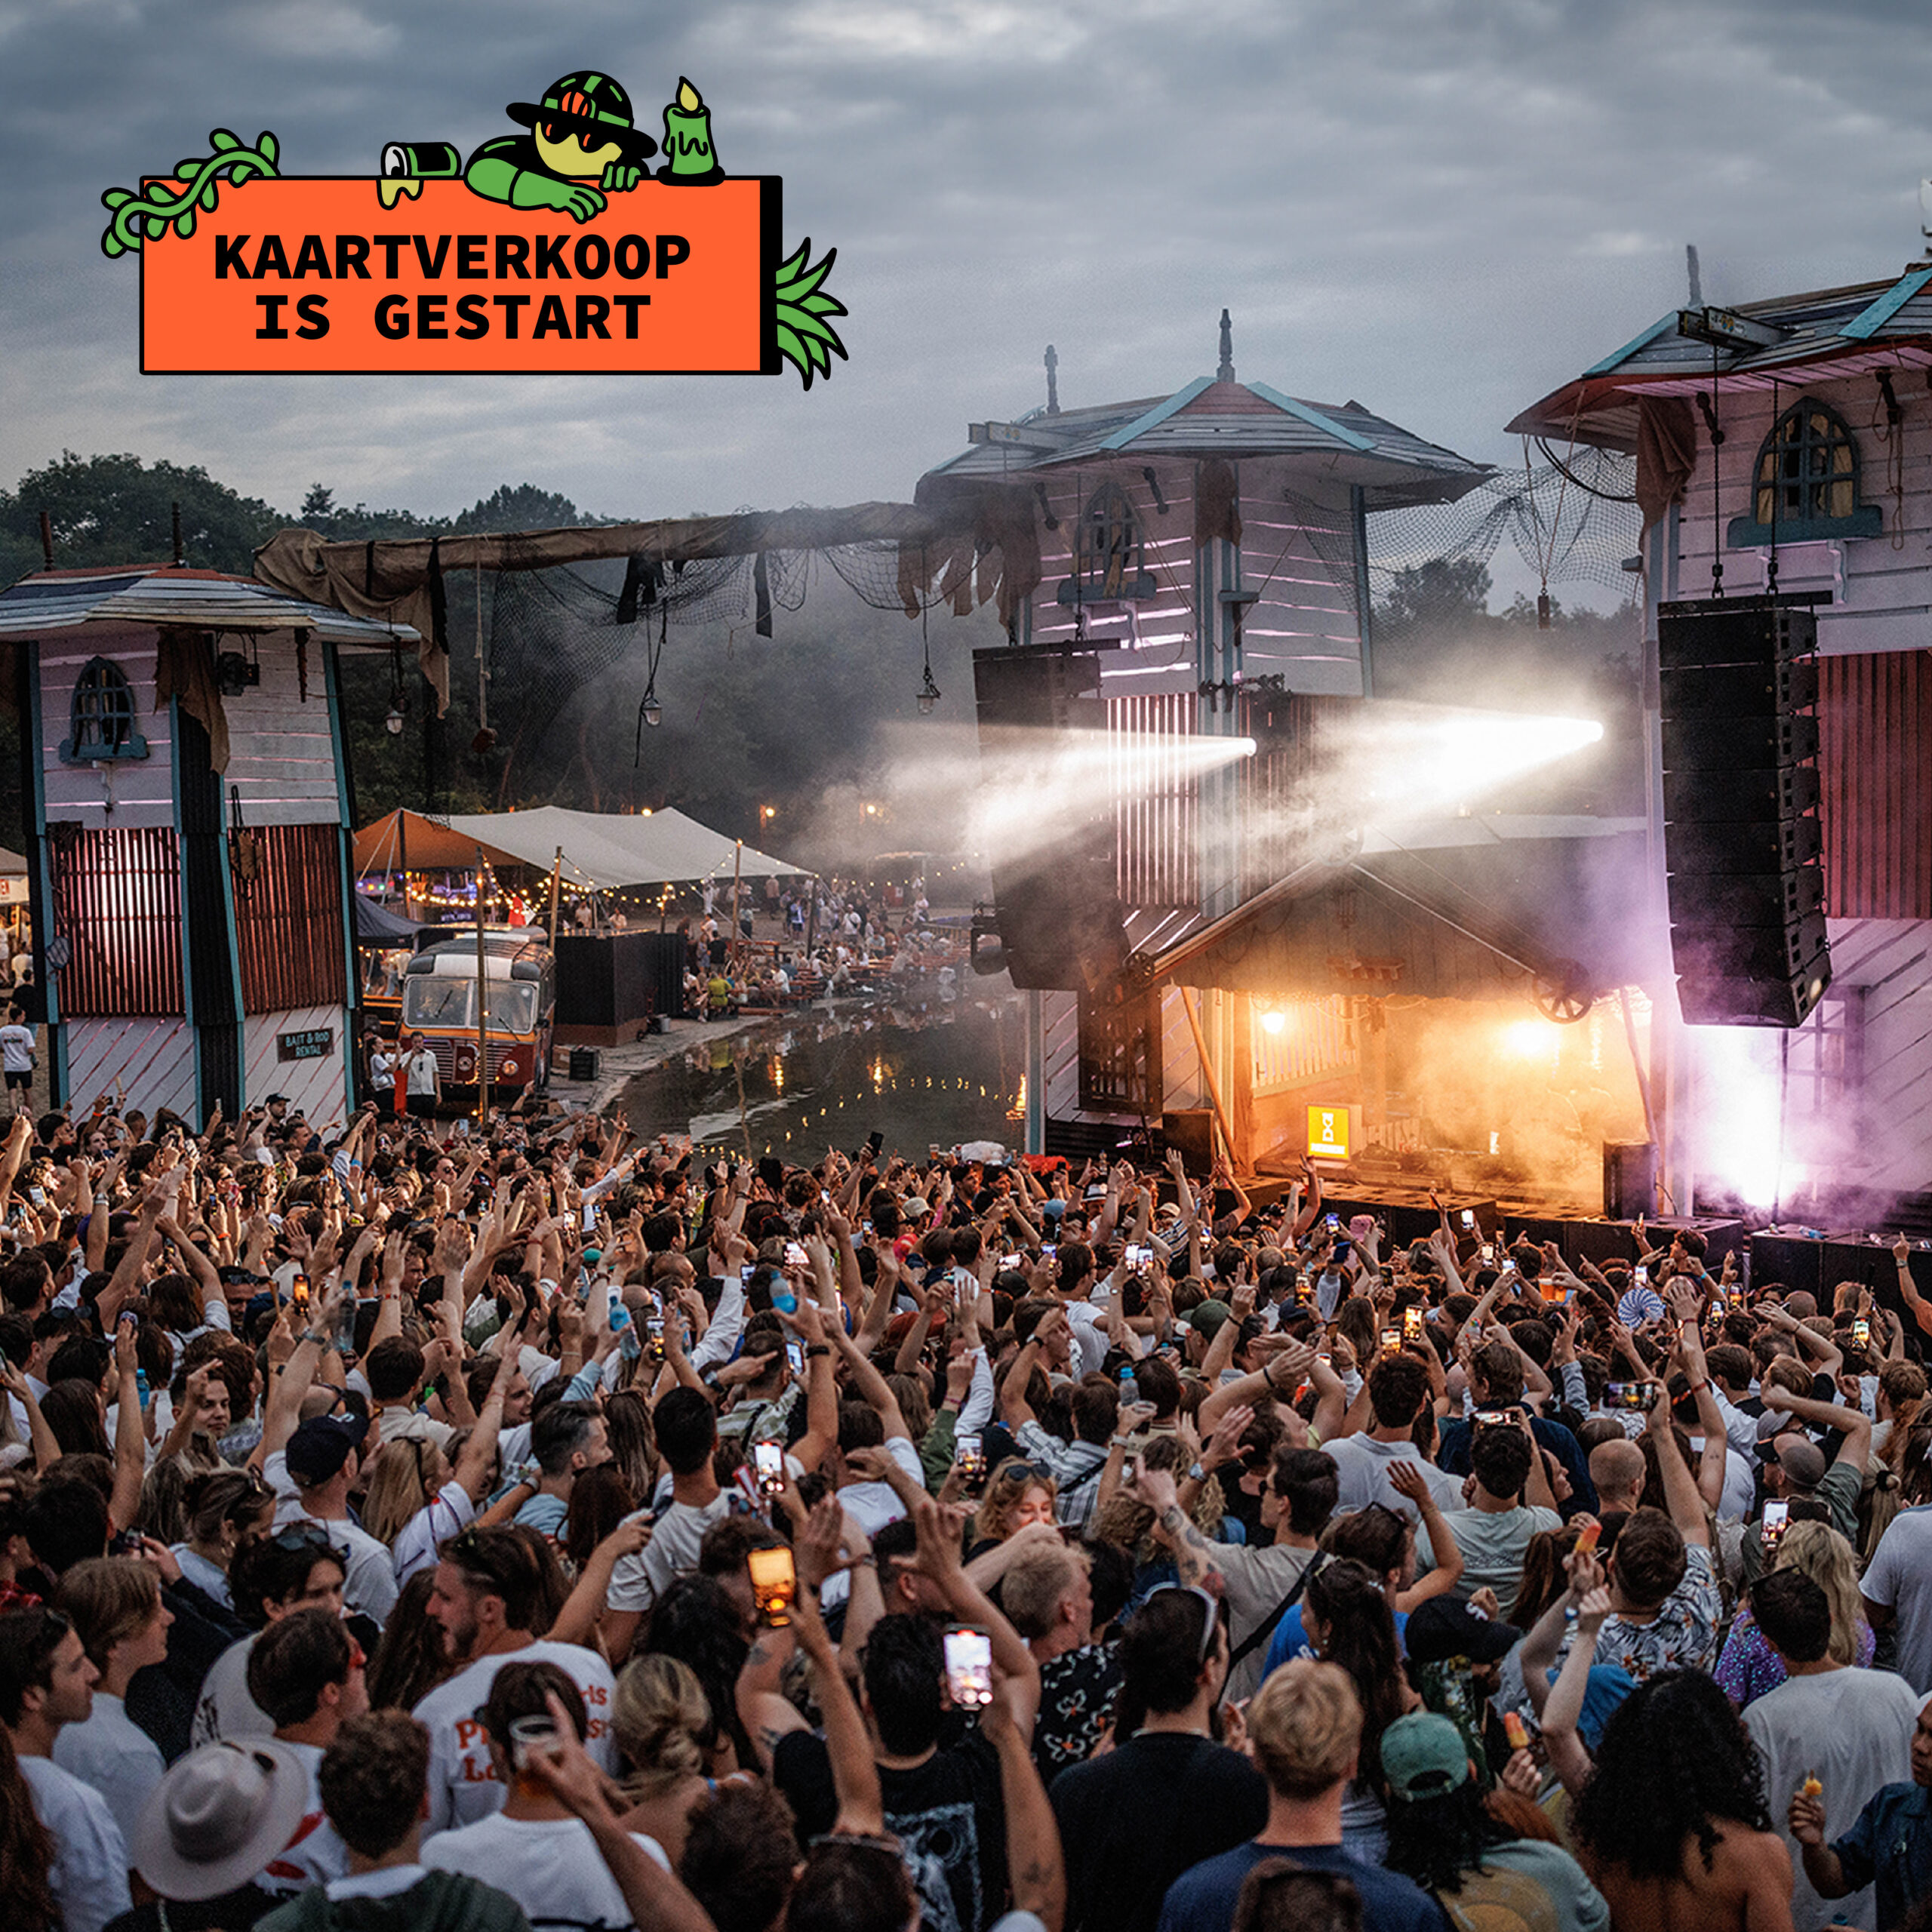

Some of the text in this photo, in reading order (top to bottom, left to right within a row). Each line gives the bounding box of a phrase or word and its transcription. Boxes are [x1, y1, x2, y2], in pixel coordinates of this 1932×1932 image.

[286, 1034, 305, 1048] BAIT
[307, 1032, 314, 1044] &
[296, 1044, 321, 1057] RENTAL
